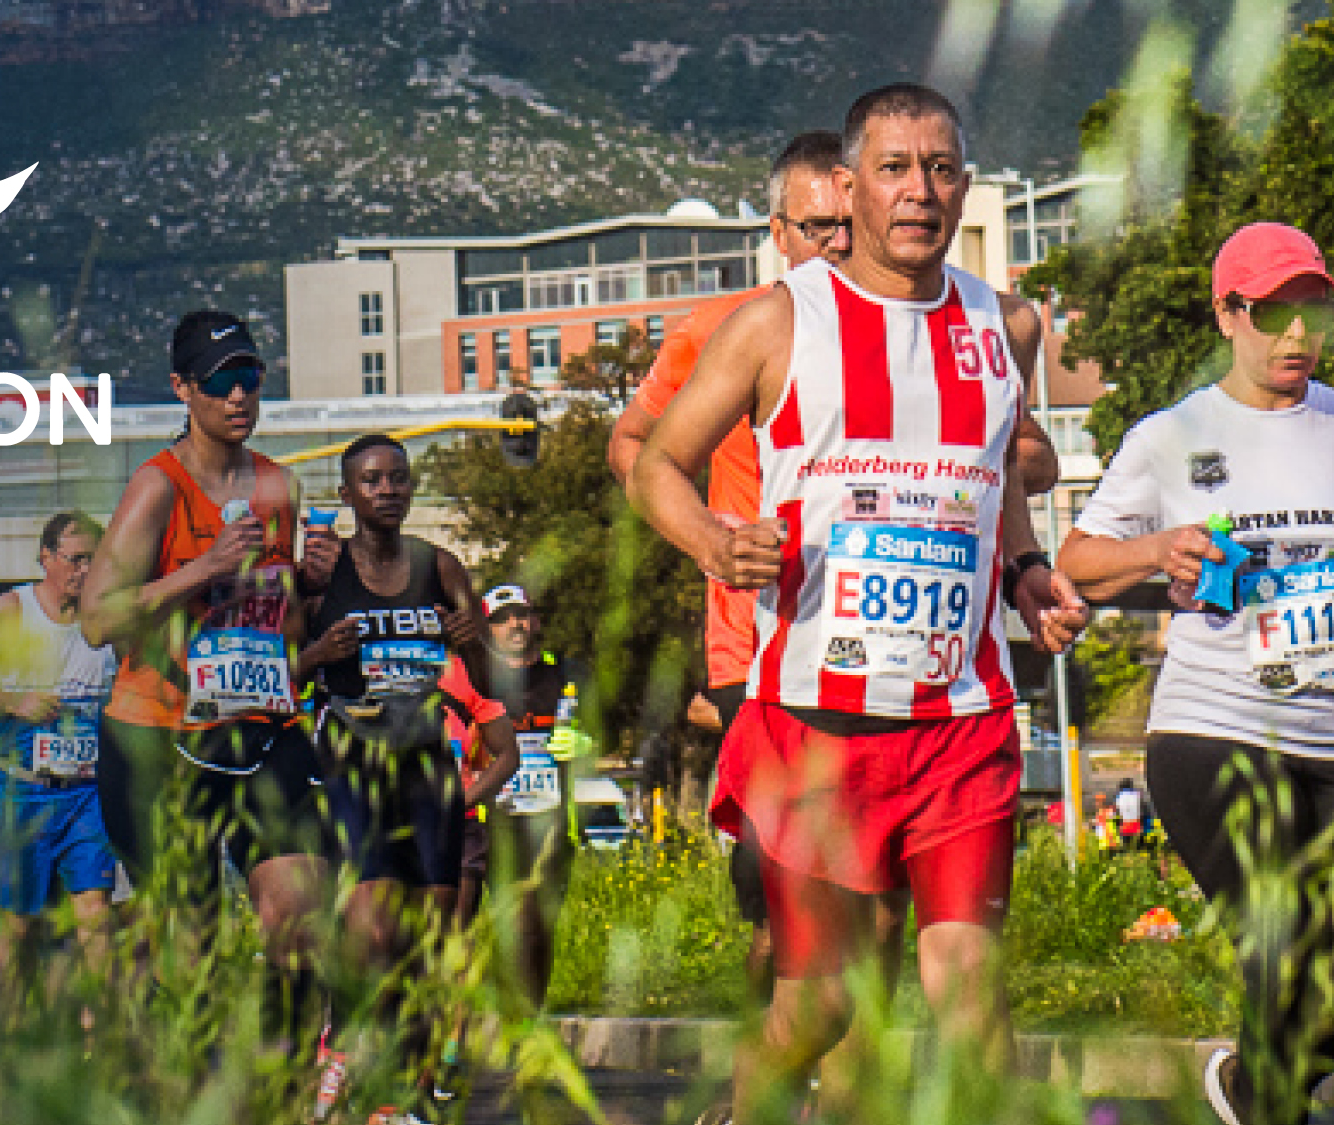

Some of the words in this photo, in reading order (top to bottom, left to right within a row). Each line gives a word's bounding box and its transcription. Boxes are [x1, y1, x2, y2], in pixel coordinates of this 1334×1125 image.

[950, 328, 1008, 380] 50
[874, 533, 967, 566] Sanlam
[834, 571, 969, 631] E8919
[928, 634, 965, 681] 50
